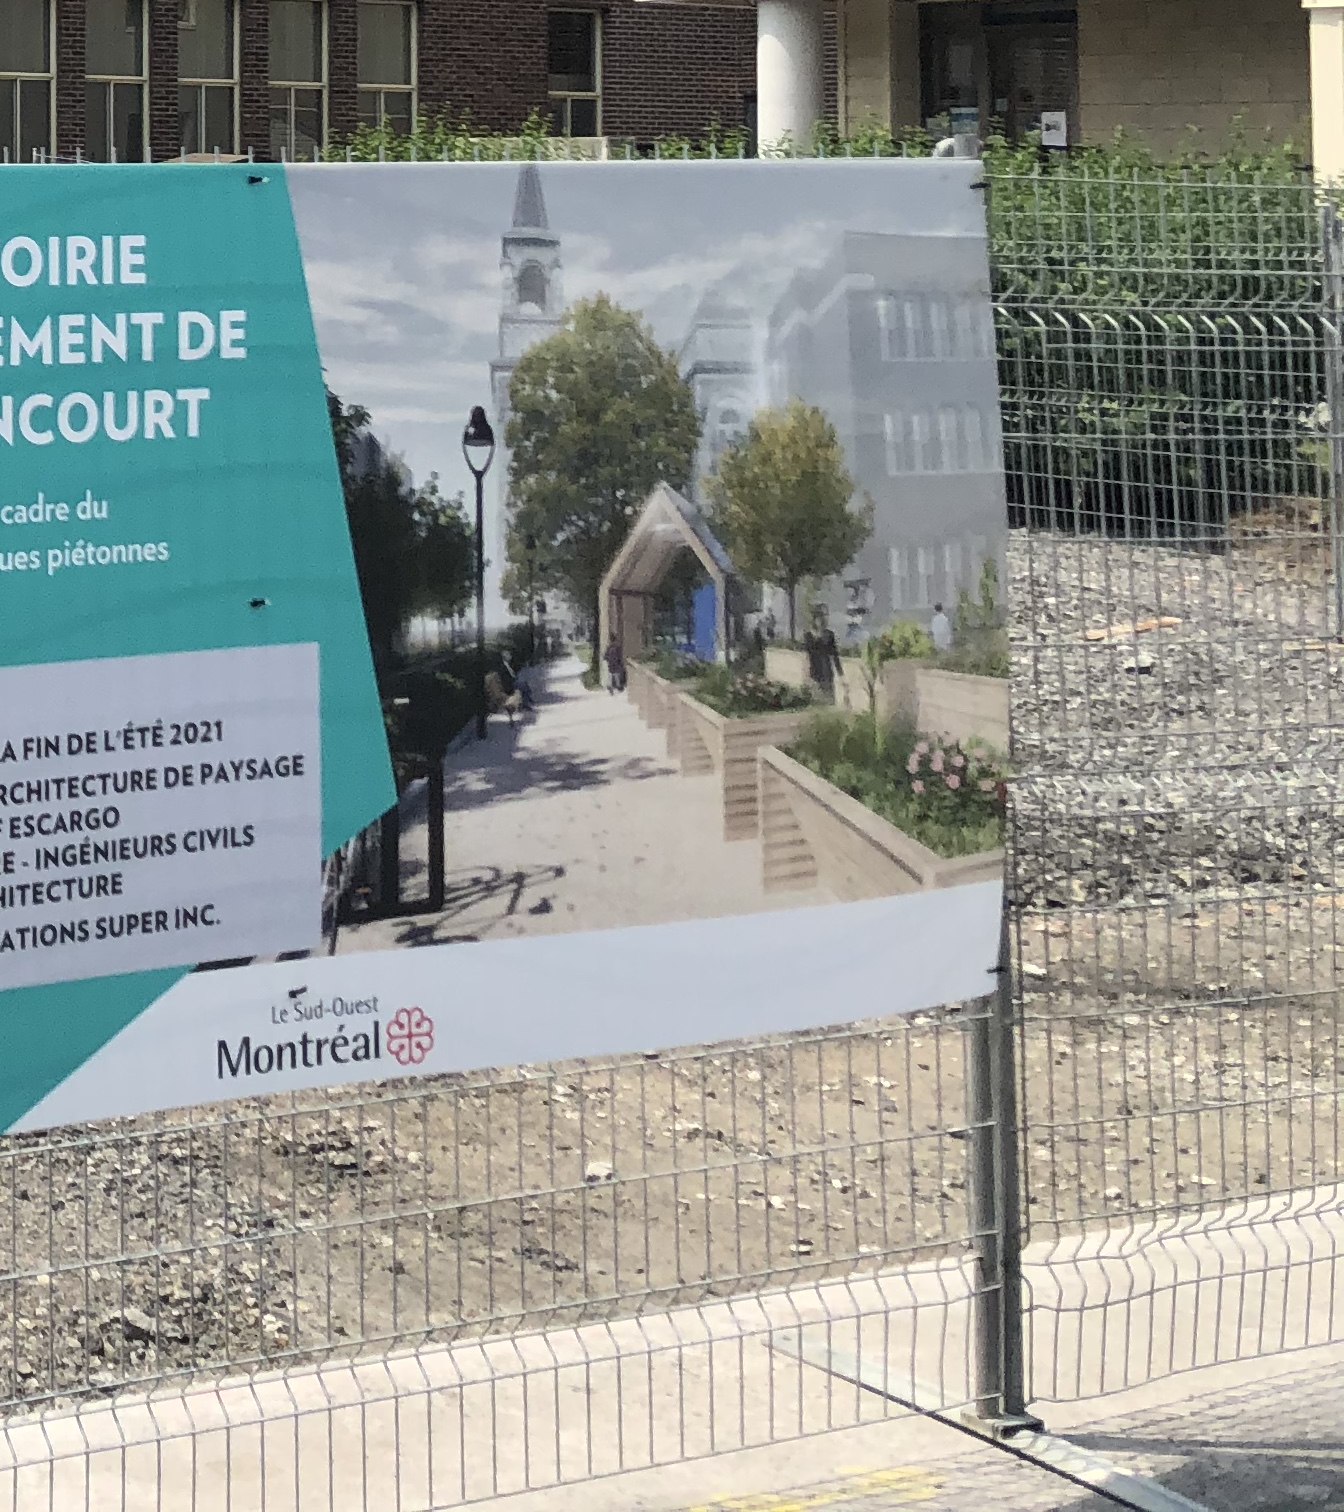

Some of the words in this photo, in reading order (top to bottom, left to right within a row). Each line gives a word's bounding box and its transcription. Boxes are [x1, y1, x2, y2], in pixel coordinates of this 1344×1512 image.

[177, 309, 247, 361] DE
[0, 492, 70, 525] cadre
[76, 489, 108, 521] du
[47, 539, 169, 576] piétonnes
[22, 735, 61, 761] FIN
[67, 731, 98, 756] DE
[103, 719, 164, 752] L'ÉTÉ
[169, 720, 223, 746] 2021
[163, 764, 194, 789] DE
[200, 754, 305, 785] PAYSAGE
[8, 805, 120, 839] ESCARGO
[35, 833, 177, 871] INGÉNIEURS
[183, 824, 255, 853] CIVILS
[95, 910, 169, 941] SUPER
[174, 903, 221, 930] INC.
[271, 1005, 289, 1025] Le
[293, 996, 379, 1022] Sud-Ouest
[217, 1020, 382, 1080] Montréal
